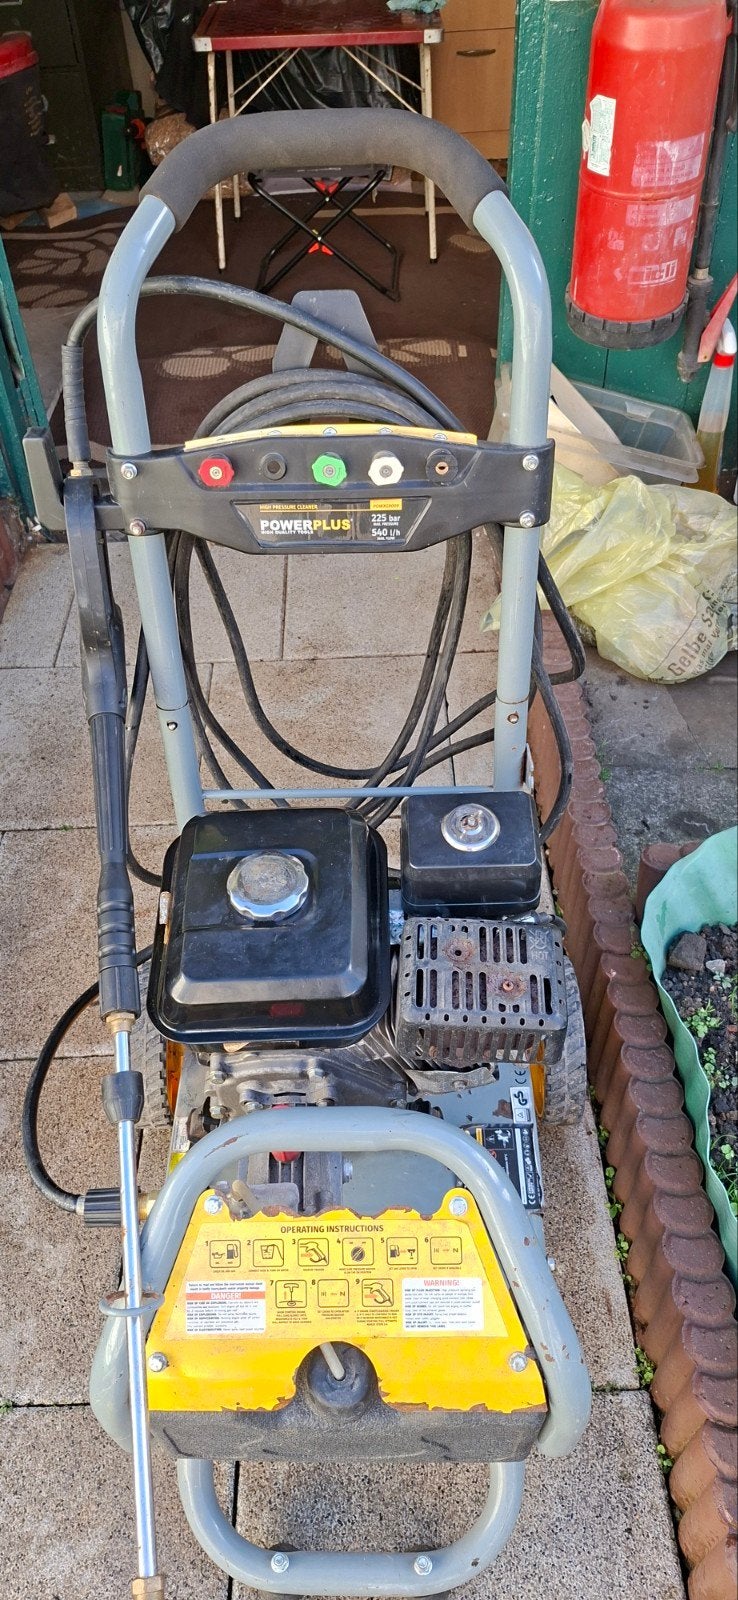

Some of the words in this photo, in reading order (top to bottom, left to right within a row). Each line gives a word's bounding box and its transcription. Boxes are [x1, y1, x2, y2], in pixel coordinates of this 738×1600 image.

[371, 513, 387, 522] 225
[388, 514, 401, 522] bar
[260, 518, 351, 531] POWERPLUS
[371, 528, 388, 537] 540
[667, 631, 707, 676] Gelbe
[531, 950, 549, 960] HOT
[513, 1090, 528, 1106] GS
[280, 1225, 325, 1234] OPERATING
[326, 1224, 384, 1233] INSTRUCTIONS
[423, 1279, 460, 1287] WARNING!
[210, 1291, 242, 1300] DANGER!
